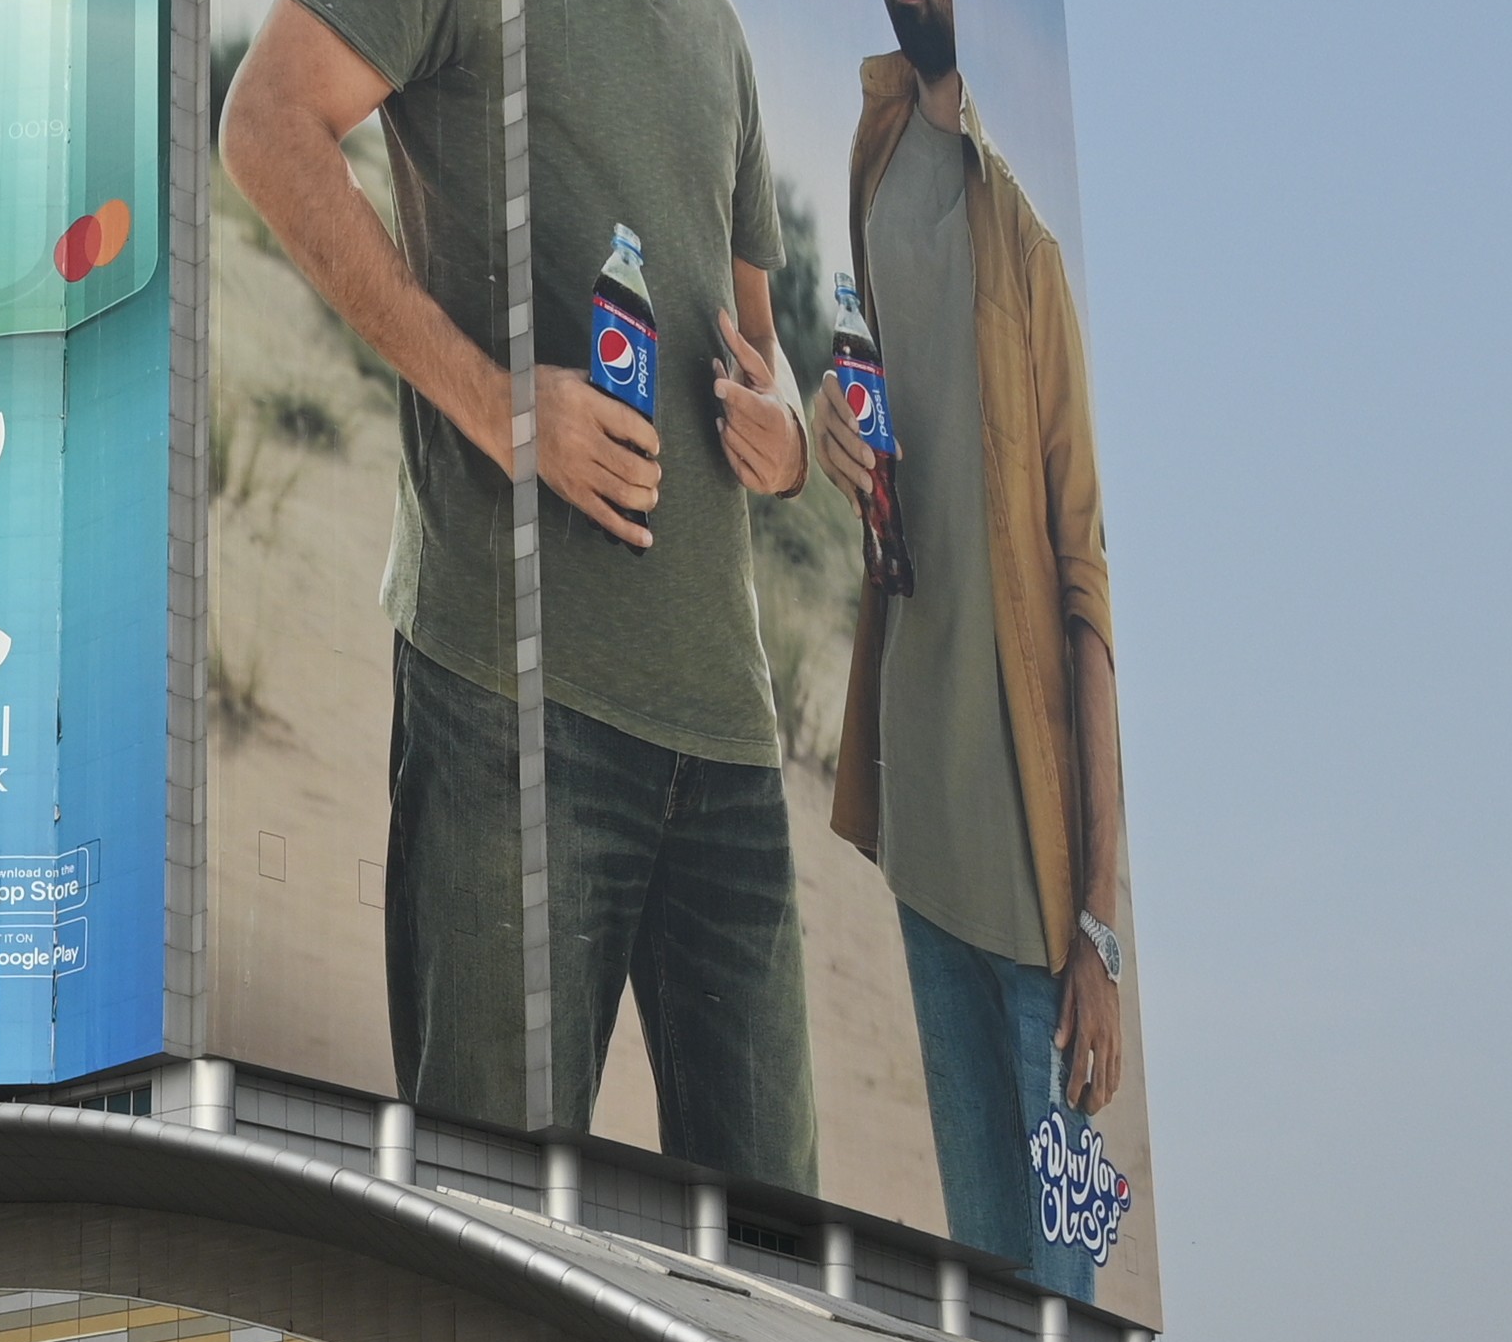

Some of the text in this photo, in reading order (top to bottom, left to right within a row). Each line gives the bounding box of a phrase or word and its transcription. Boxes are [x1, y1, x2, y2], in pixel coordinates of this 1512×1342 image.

[638, 346, 649, 398] pepsi
[872, 388, 888, 438] pepsi
[45, 868, 59, 879] on
[60, 863, 75, 876] the
[30, 878, 79, 901] Store
[2, 934, 11, 945] IT
[17, 933, 34, 944] ON
[53, 944, 79, 966] Play
